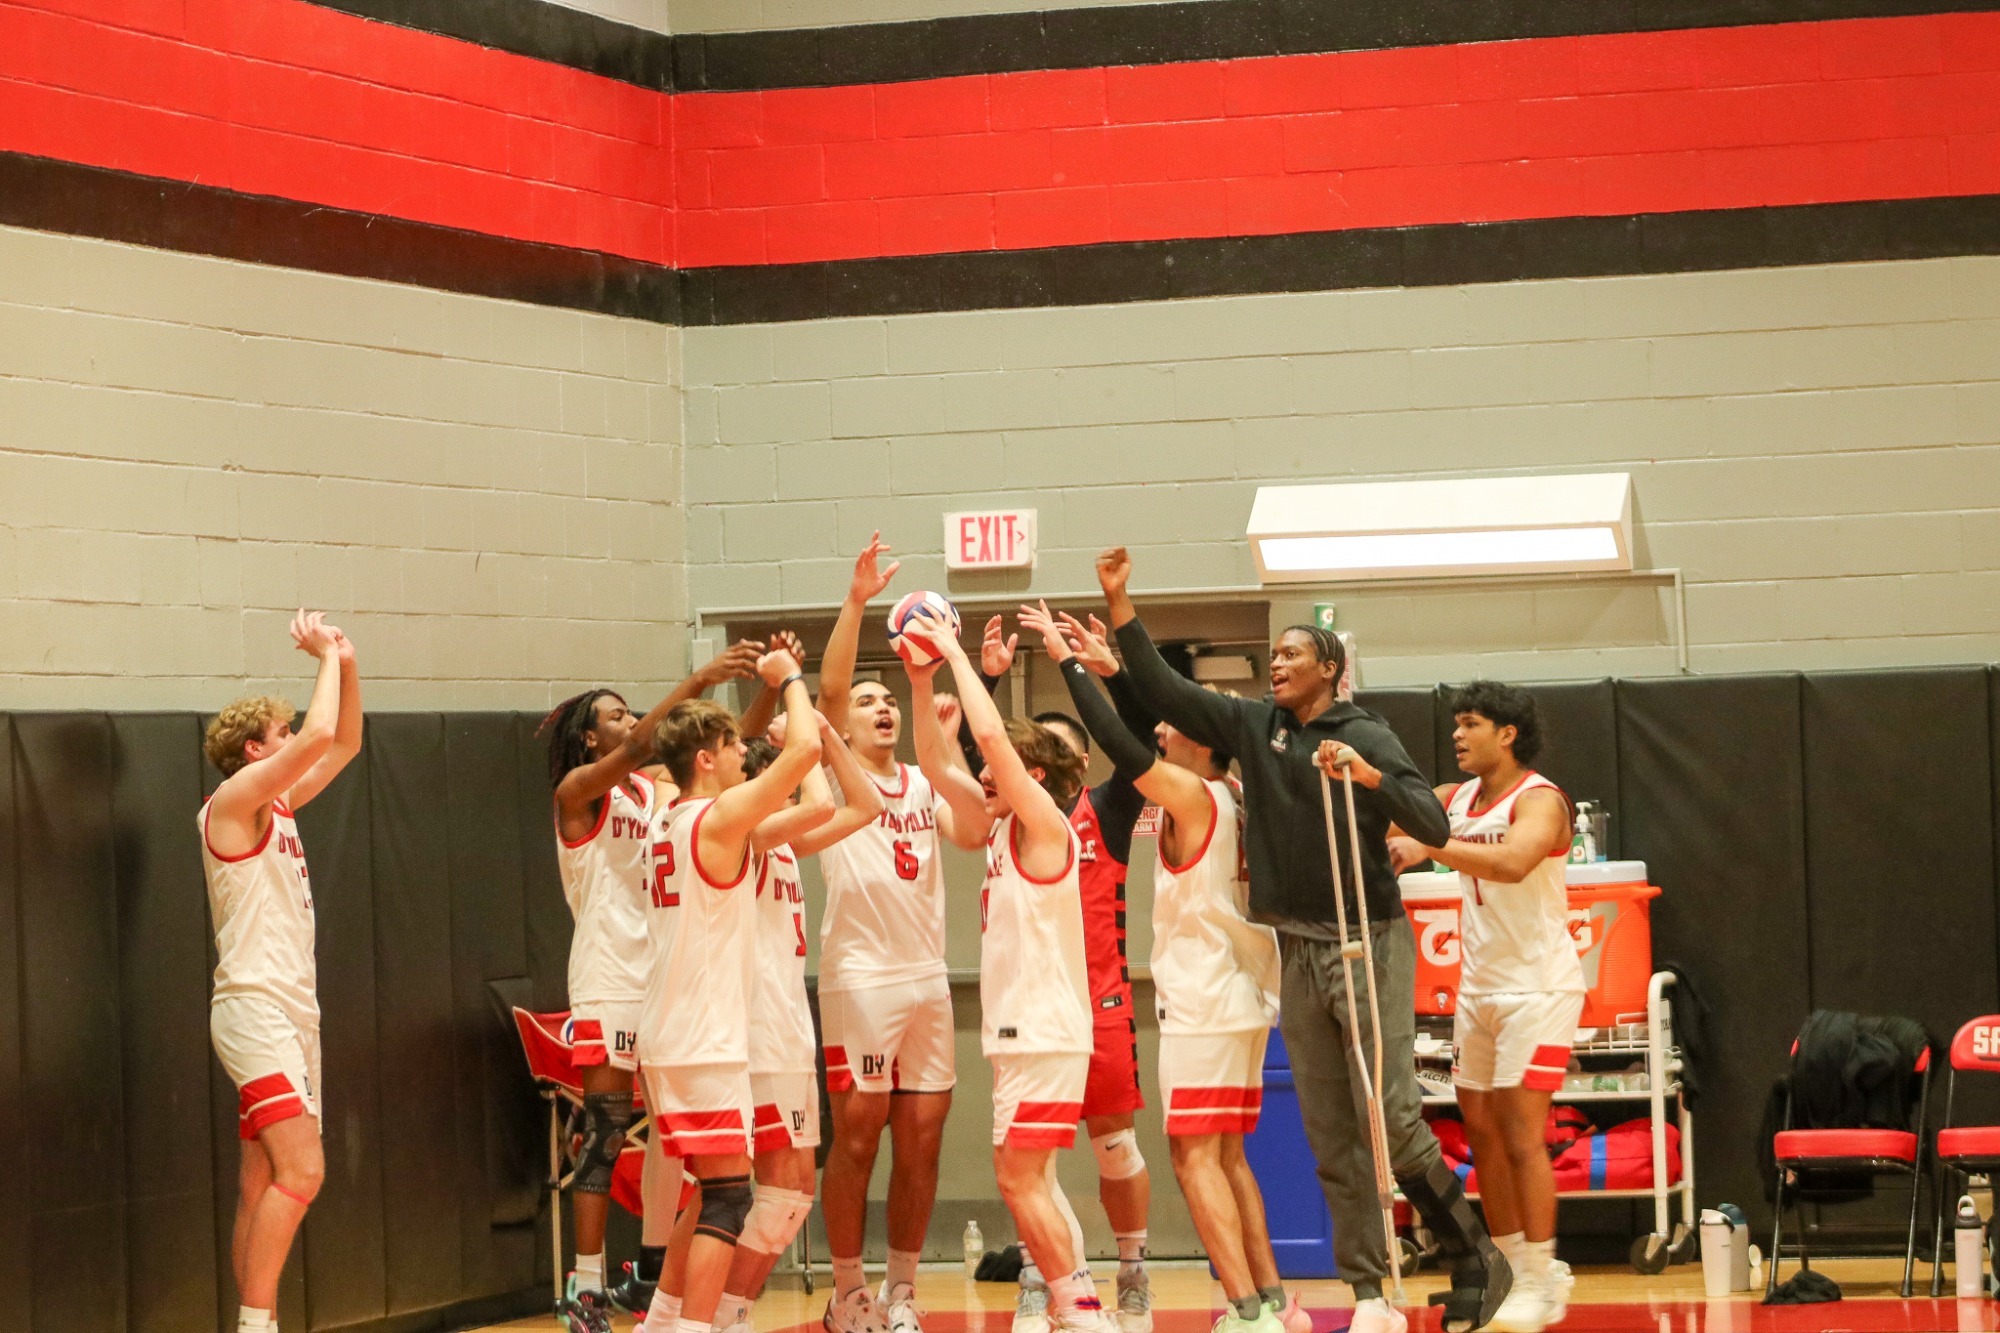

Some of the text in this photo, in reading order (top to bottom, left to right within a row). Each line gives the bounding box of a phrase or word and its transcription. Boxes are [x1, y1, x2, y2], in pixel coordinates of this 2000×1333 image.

[960, 515, 1017, 563] EXIT
[893, 839, 919, 881] 6
[1414, 909, 1461, 966] G
[1567, 908, 1593, 951] G
[614, 1030, 637, 1052] DY
[862, 1054, 885, 1075] DY
[791, 1109, 806, 1131] DY
